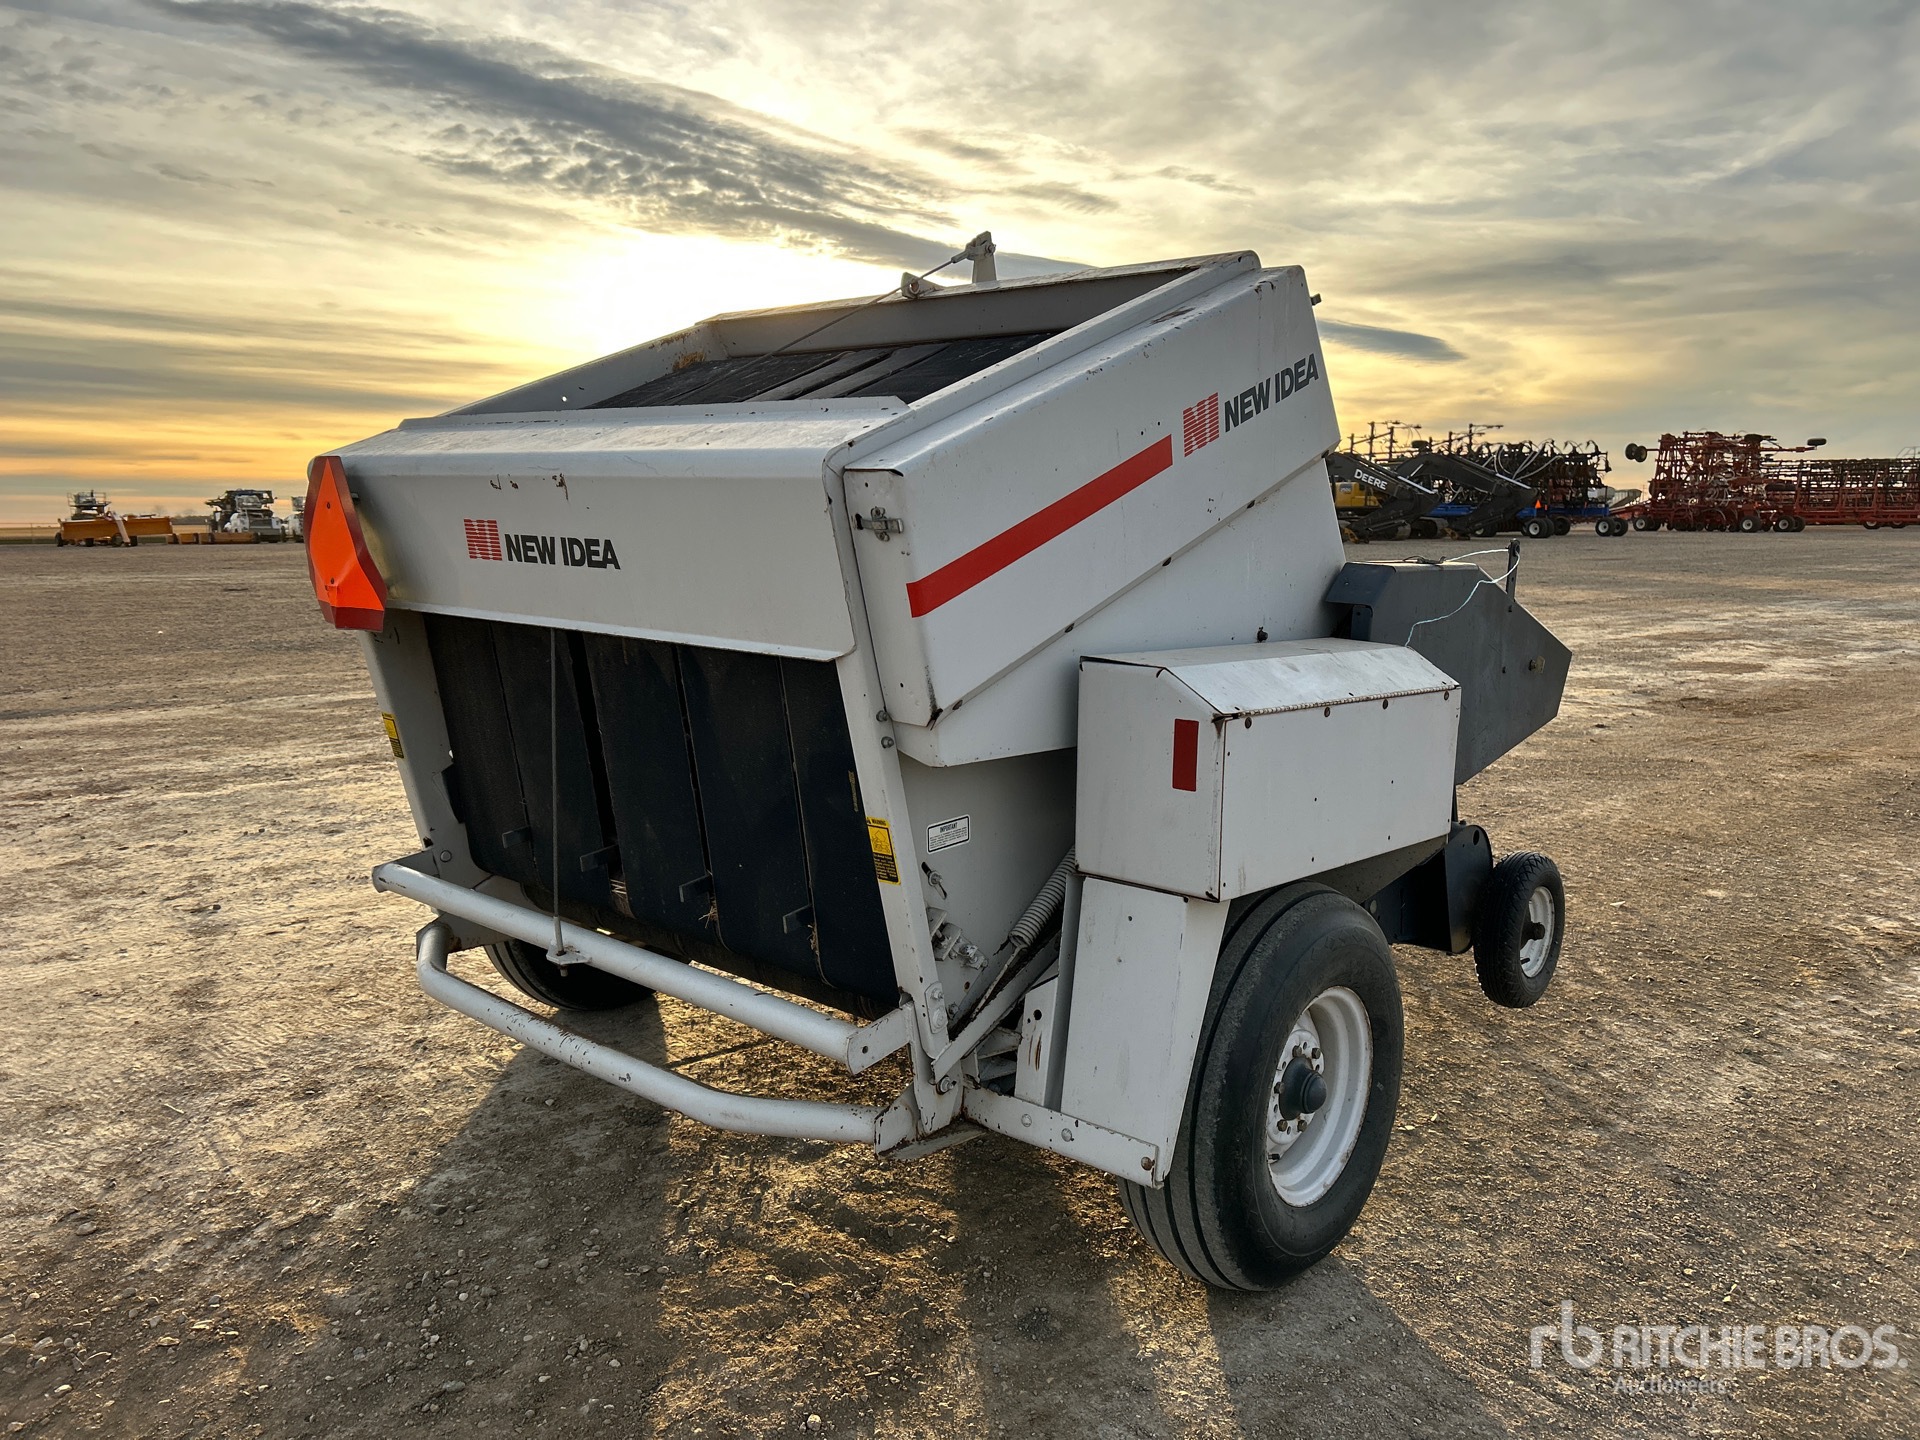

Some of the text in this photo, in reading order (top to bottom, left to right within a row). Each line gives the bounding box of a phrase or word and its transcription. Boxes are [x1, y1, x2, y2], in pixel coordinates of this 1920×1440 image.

[1224, 377, 1271, 433] NEW
[1275, 353, 1319, 404] IDEA
[1354, 469, 1388, 490] DEERE
[504, 534, 556, 565] NEW
[560, 537, 621, 570] IDEA
